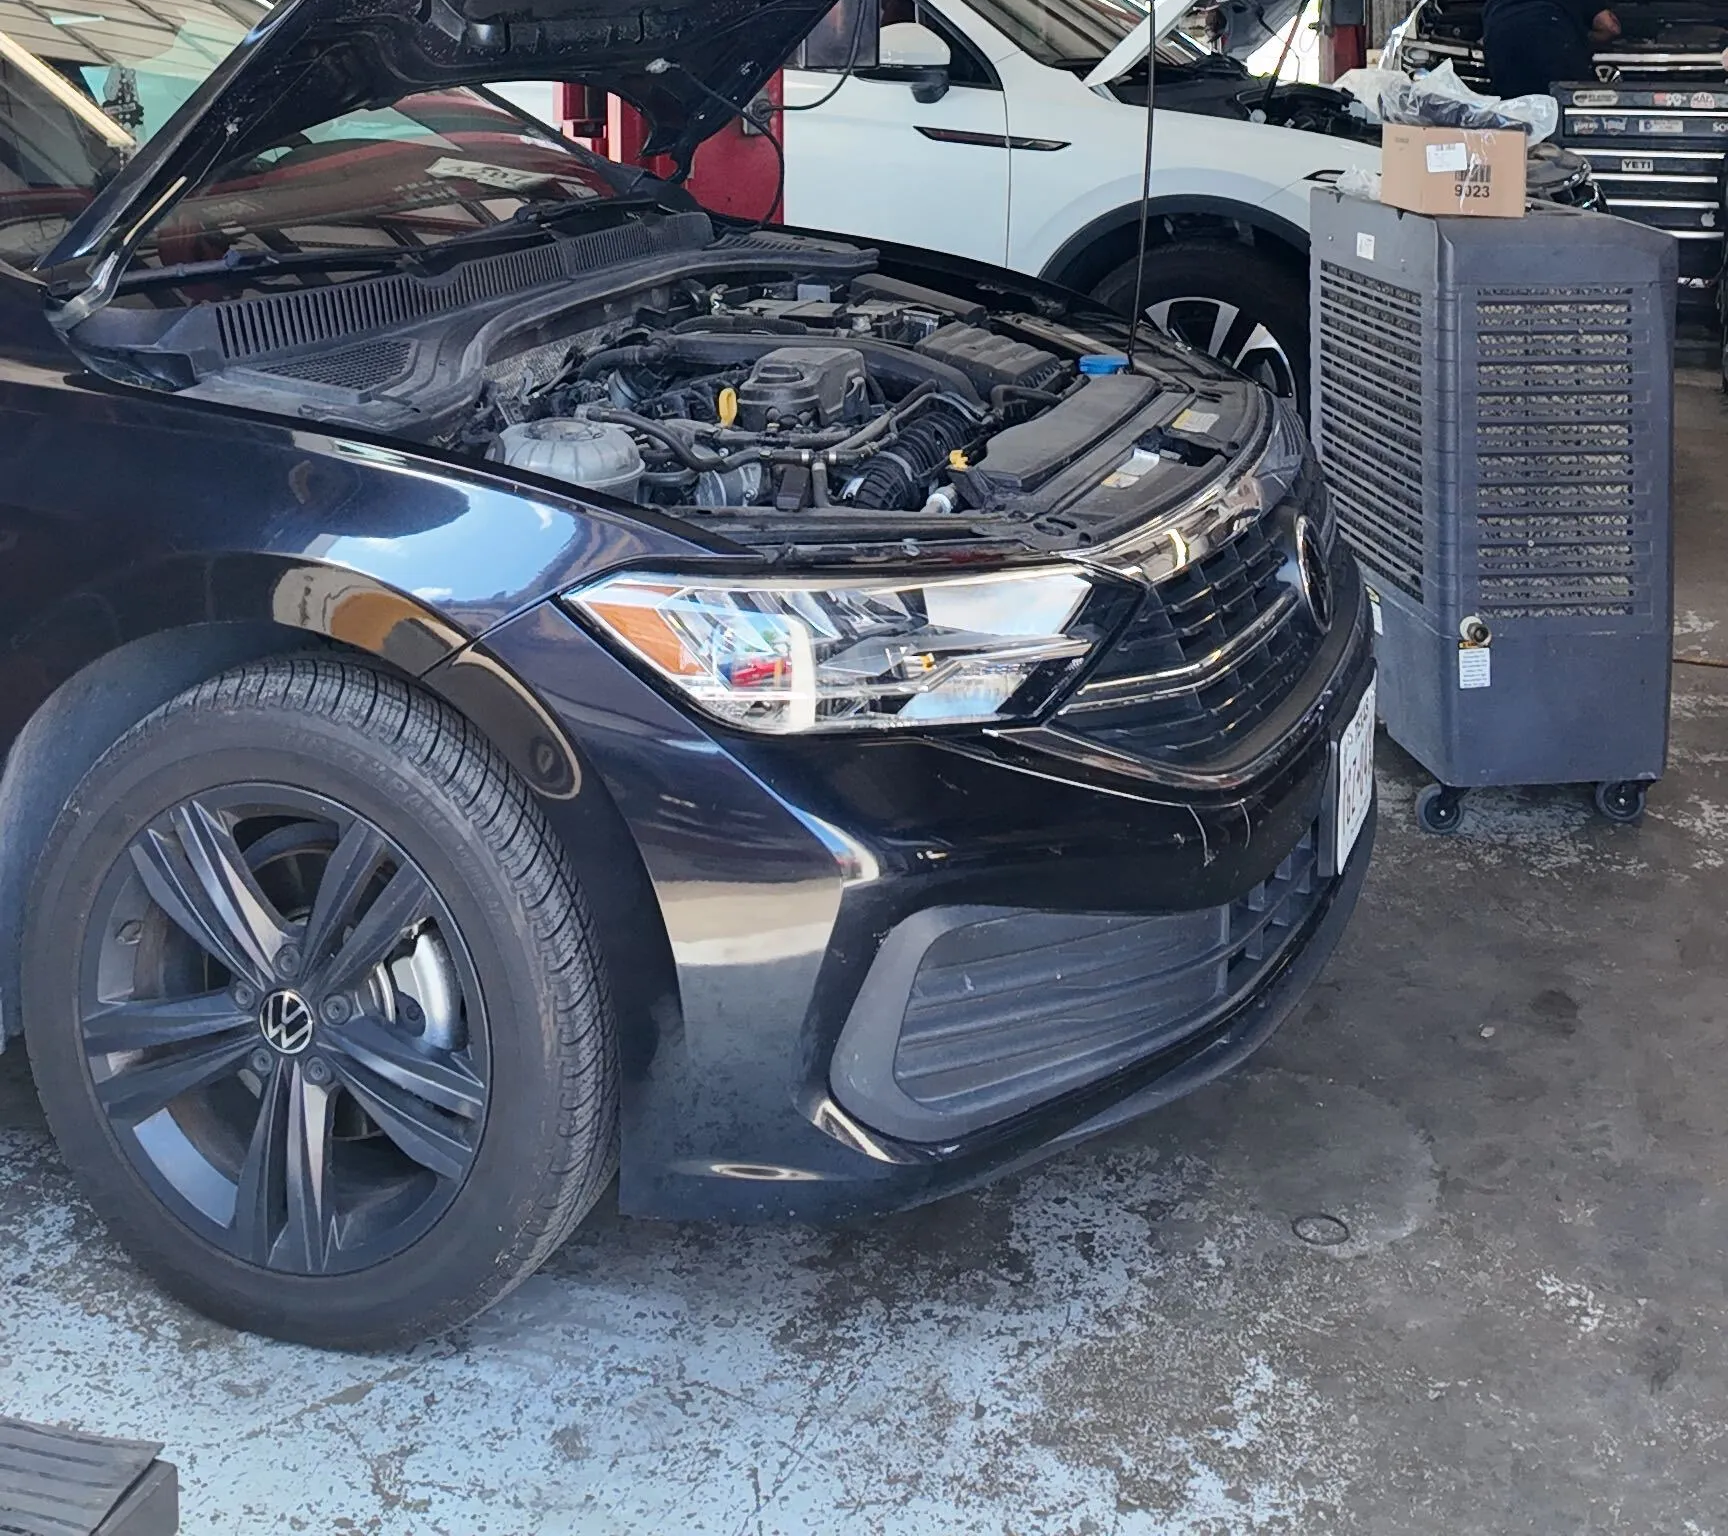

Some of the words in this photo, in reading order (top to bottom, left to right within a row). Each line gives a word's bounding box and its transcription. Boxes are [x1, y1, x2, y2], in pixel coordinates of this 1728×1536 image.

[1712, 121, 1728, 133] SO
[1623, 160, 1651, 169] YETI
[1454, 184, 1490, 198] 9023
